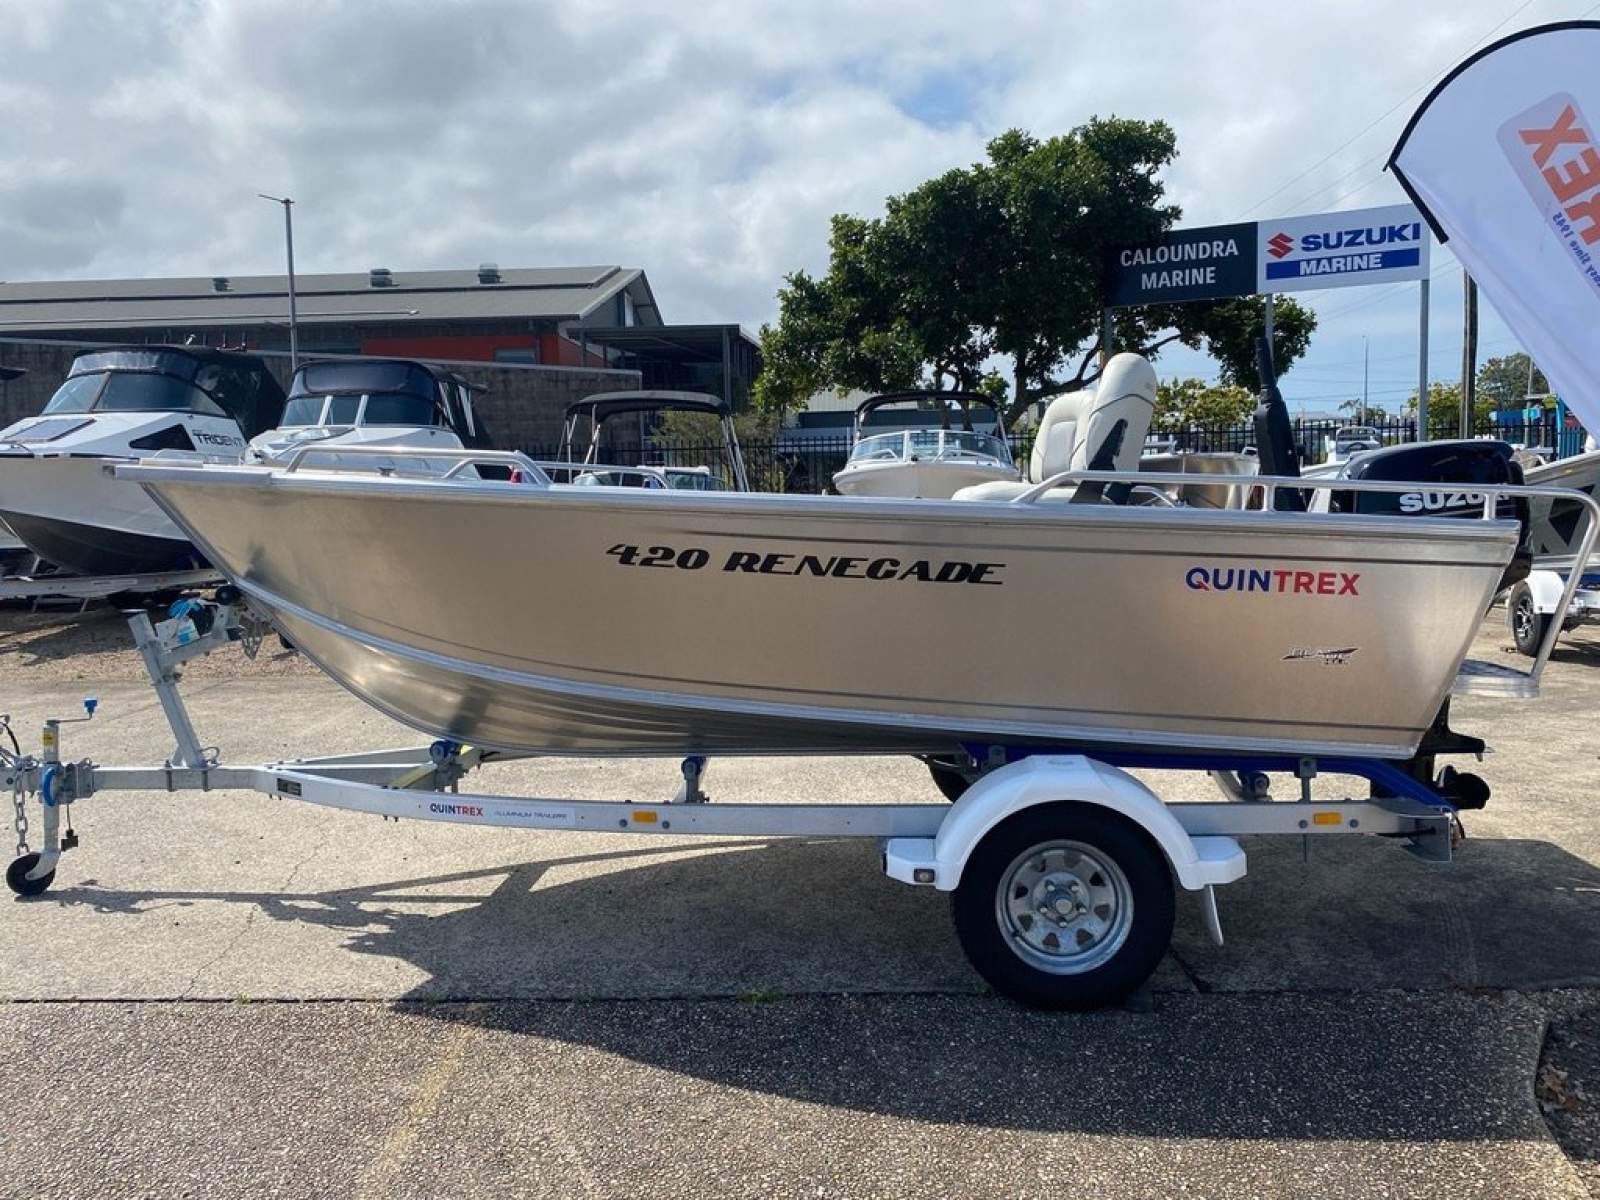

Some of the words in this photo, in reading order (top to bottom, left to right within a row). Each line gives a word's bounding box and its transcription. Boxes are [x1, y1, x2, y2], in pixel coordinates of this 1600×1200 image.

[1301, 222, 1421, 252] SUZUKI
[1120, 239, 1239, 267] CALOUNDRA
[1300, 252, 1382, 276] MARINE
[1141, 266, 1216, 290] MARINE
[606, 543, 710, 570] 420
[722, 550, 1006, 585] RENEGADE
[1185, 566, 1361, 596] QUINTREX
[429, 802, 484, 817] QUINTREX
